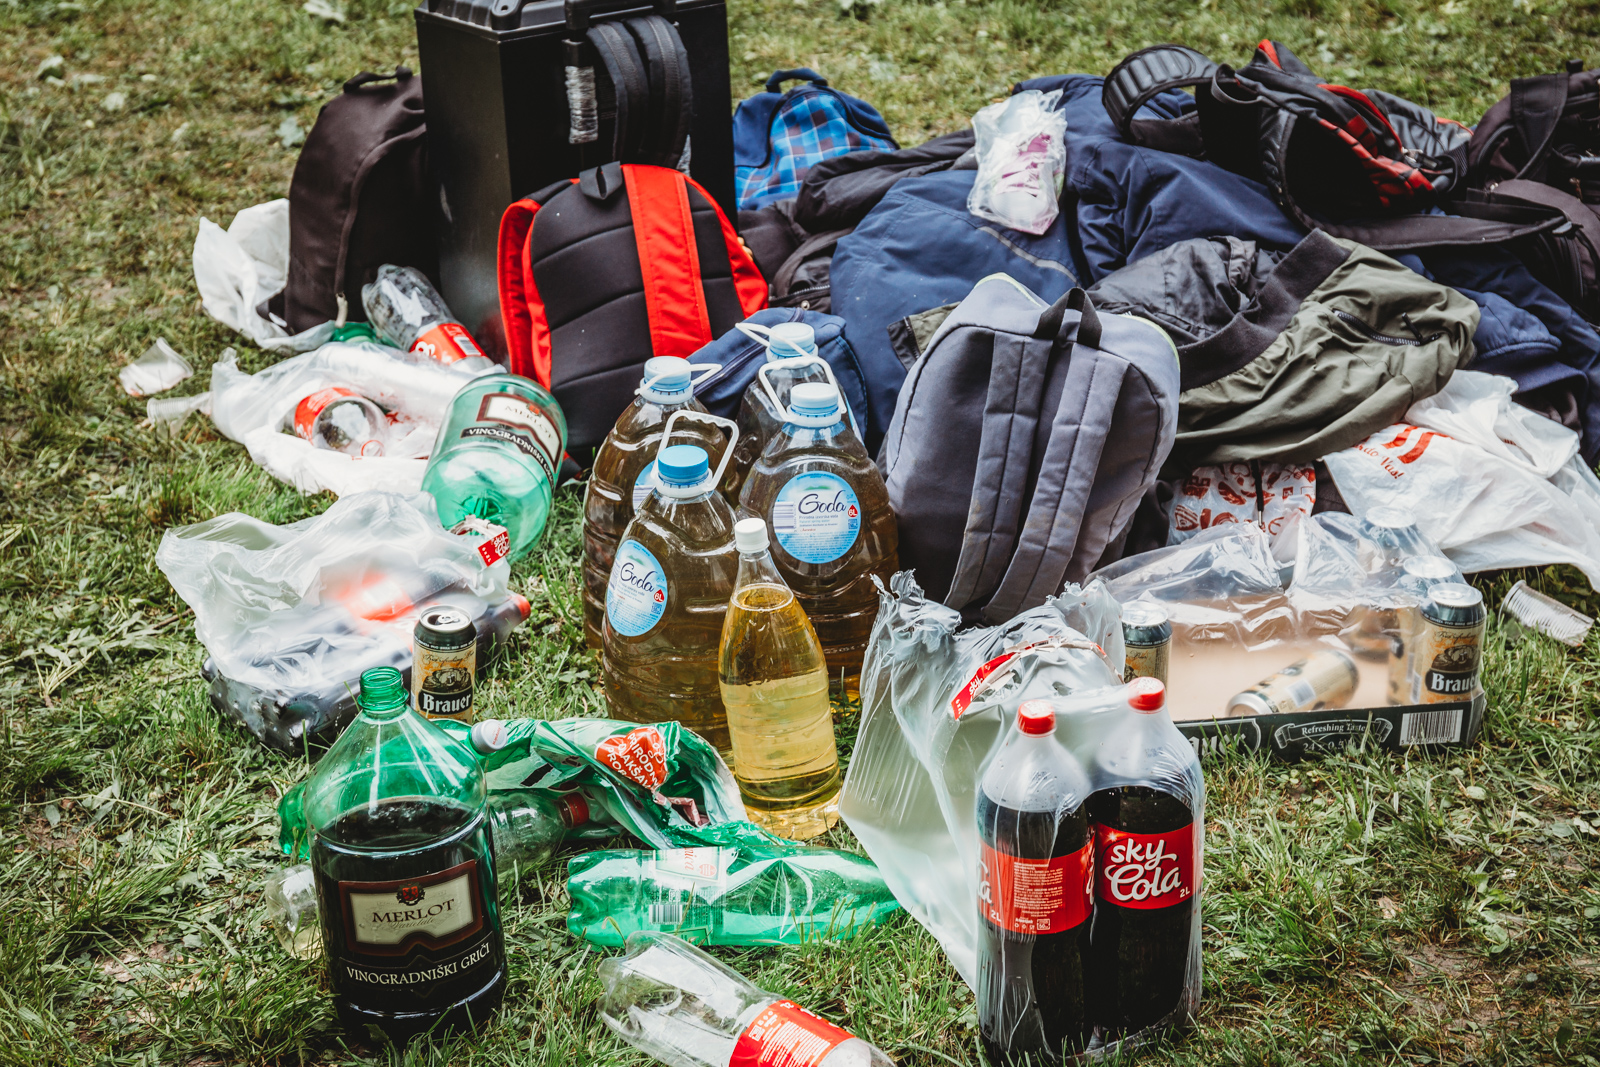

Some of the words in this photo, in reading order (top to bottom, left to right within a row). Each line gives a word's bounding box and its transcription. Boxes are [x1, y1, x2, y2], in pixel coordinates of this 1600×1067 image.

[798, 490, 846, 514] Goda
[620, 562, 657, 592] Goda
[654, 592, 664, 602] 6L
[423, 692, 471, 713] Brauer
[1301, 723, 1344, 735] Refreshing
[628, 733, 658, 786] PRIRODN
[1111, 838, 1177, 870] sky
[1104, 864, 1181, 901] Cola
[1180, 887, 1190, 898] 2L
[372, 898, 454, 923] MERLOT
[991, 909, 1002, 922] 2L
[346, 962, 458, 985] VINOGRADNIŠKI
[460, 942, 490, 969] GRIČI
